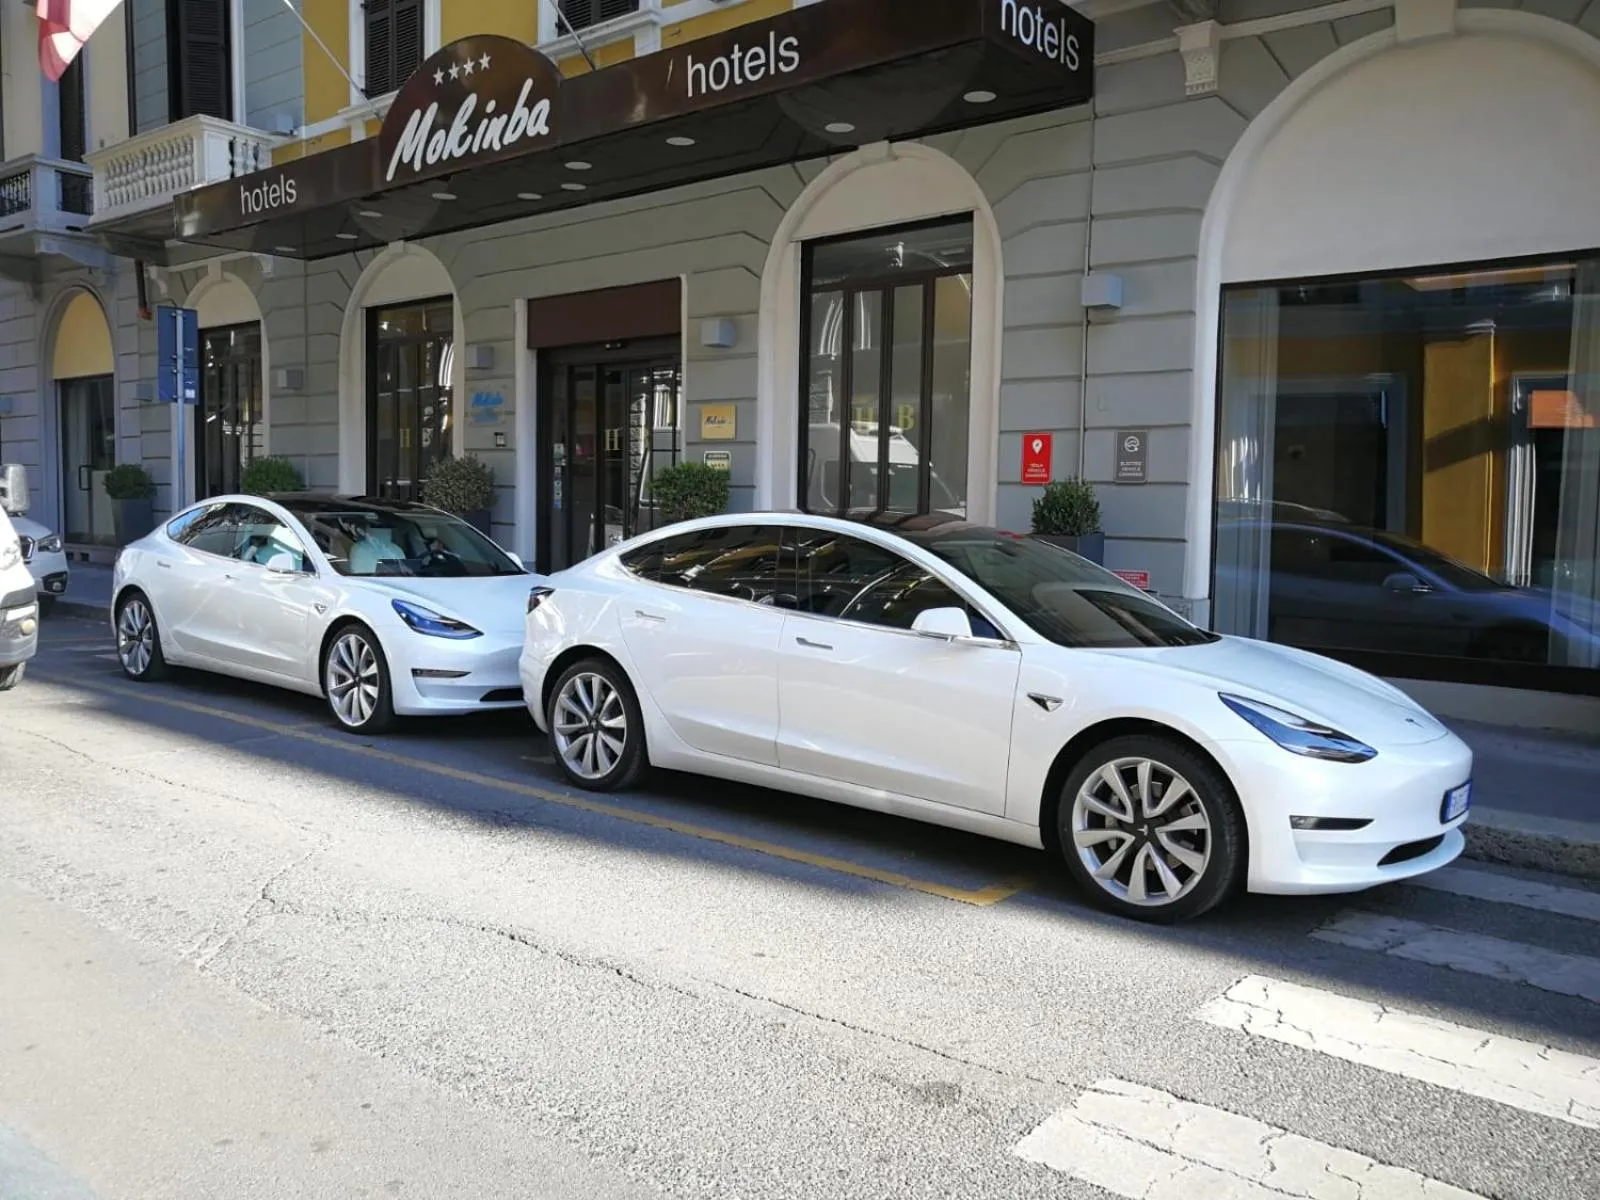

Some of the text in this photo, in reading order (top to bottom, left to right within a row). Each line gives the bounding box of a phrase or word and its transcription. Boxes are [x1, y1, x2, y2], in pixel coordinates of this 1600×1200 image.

[687, 30, 800, 98] hotels
[386, 77, 550, 182] Mokinba
[240, 173, 297, 216] hotels
[897, 404, 915, 431] B
